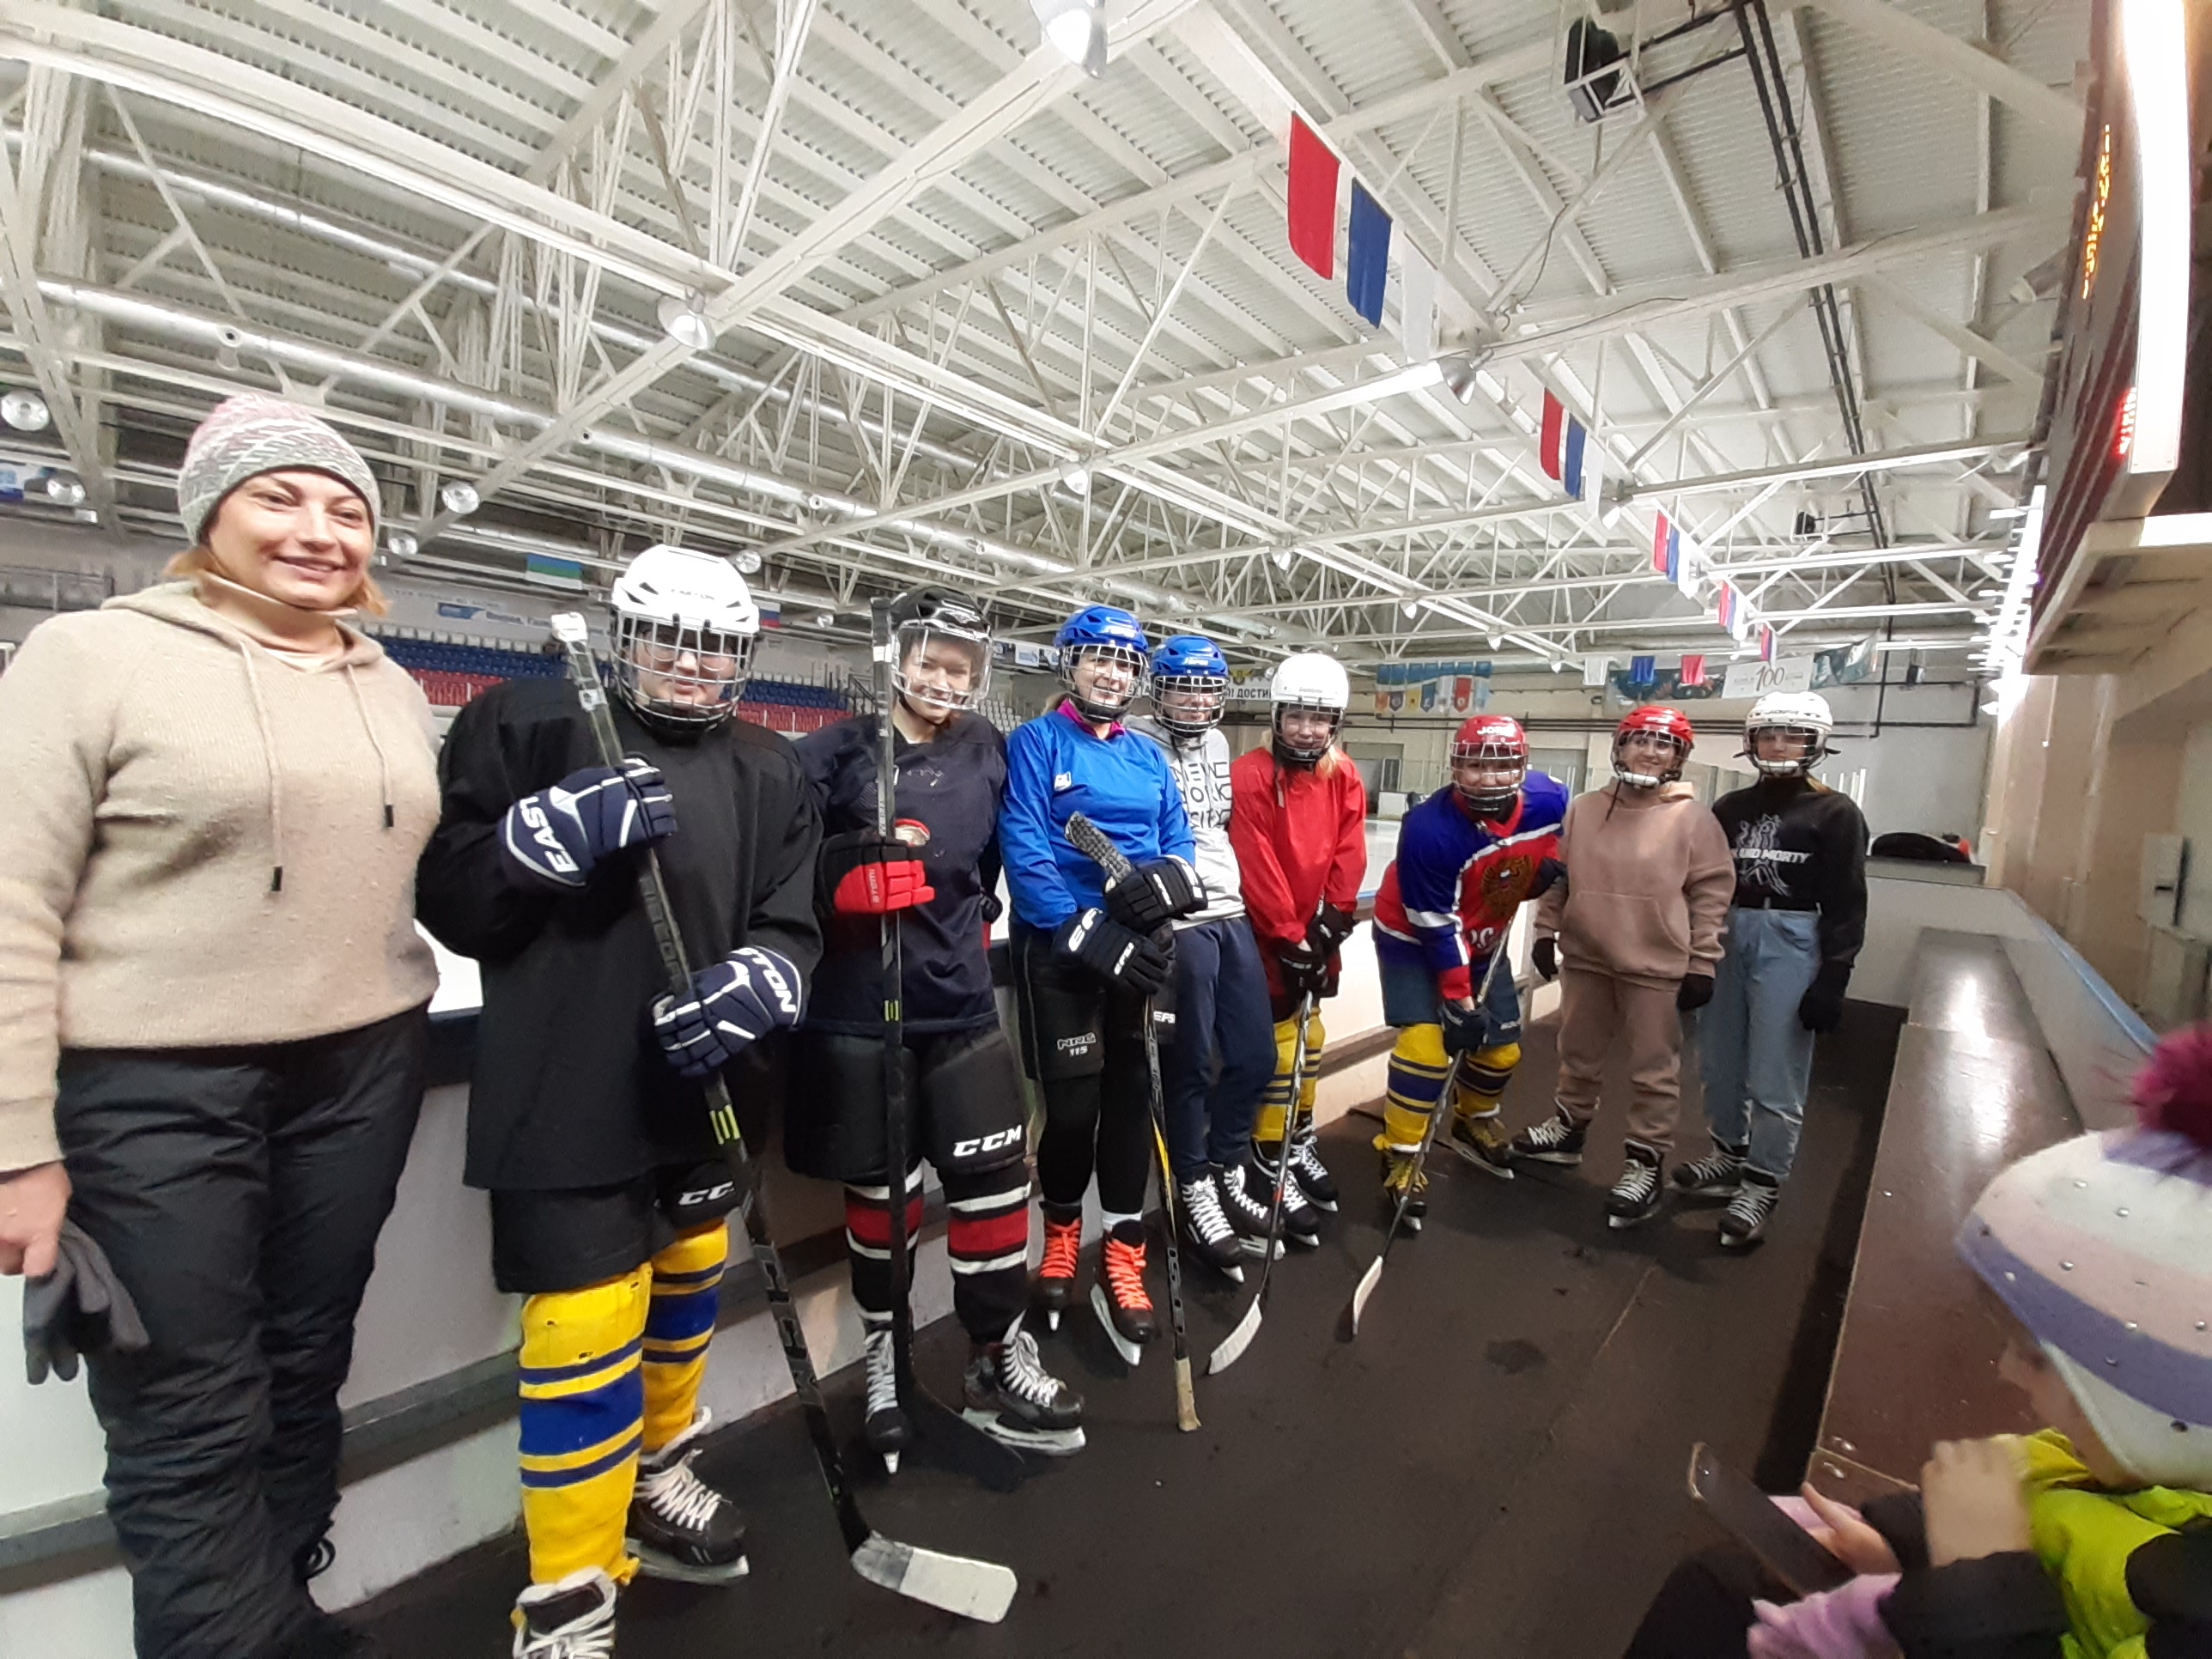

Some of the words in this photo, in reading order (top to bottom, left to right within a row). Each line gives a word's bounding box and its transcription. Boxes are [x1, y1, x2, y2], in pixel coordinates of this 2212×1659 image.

[1755, 665, 1785, 691] 100
[1237, 687, 1272, 699] ДОСТИ
[1069, 1045, 1089, 1057] 115
[953, 1125, 1022, 1158] CCM
[678, 1181, 735, 1206] CC
